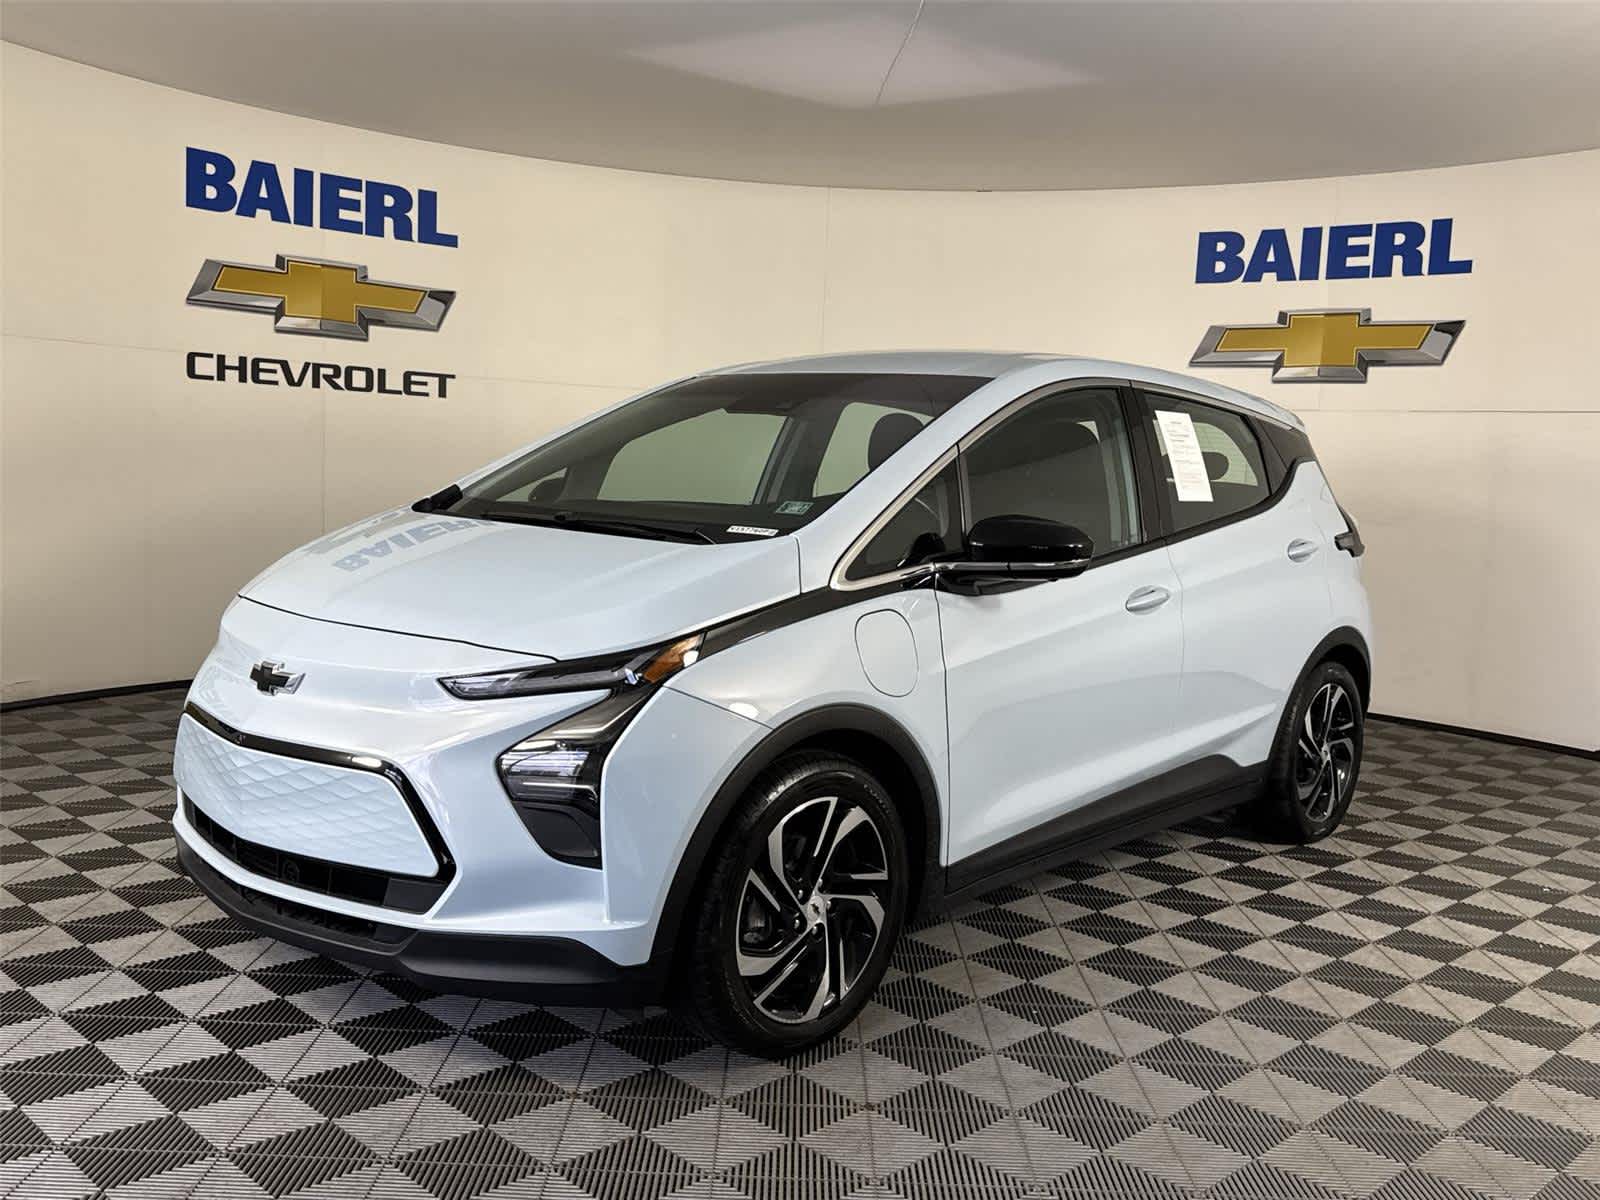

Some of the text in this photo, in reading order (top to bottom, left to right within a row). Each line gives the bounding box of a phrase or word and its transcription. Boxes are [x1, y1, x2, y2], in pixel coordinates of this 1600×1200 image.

[186, 147, 458, 248] BAIERL
[1195, 218, 1473, 284] BAIERL
[186, 351, 456, 398] CHEVROLET
